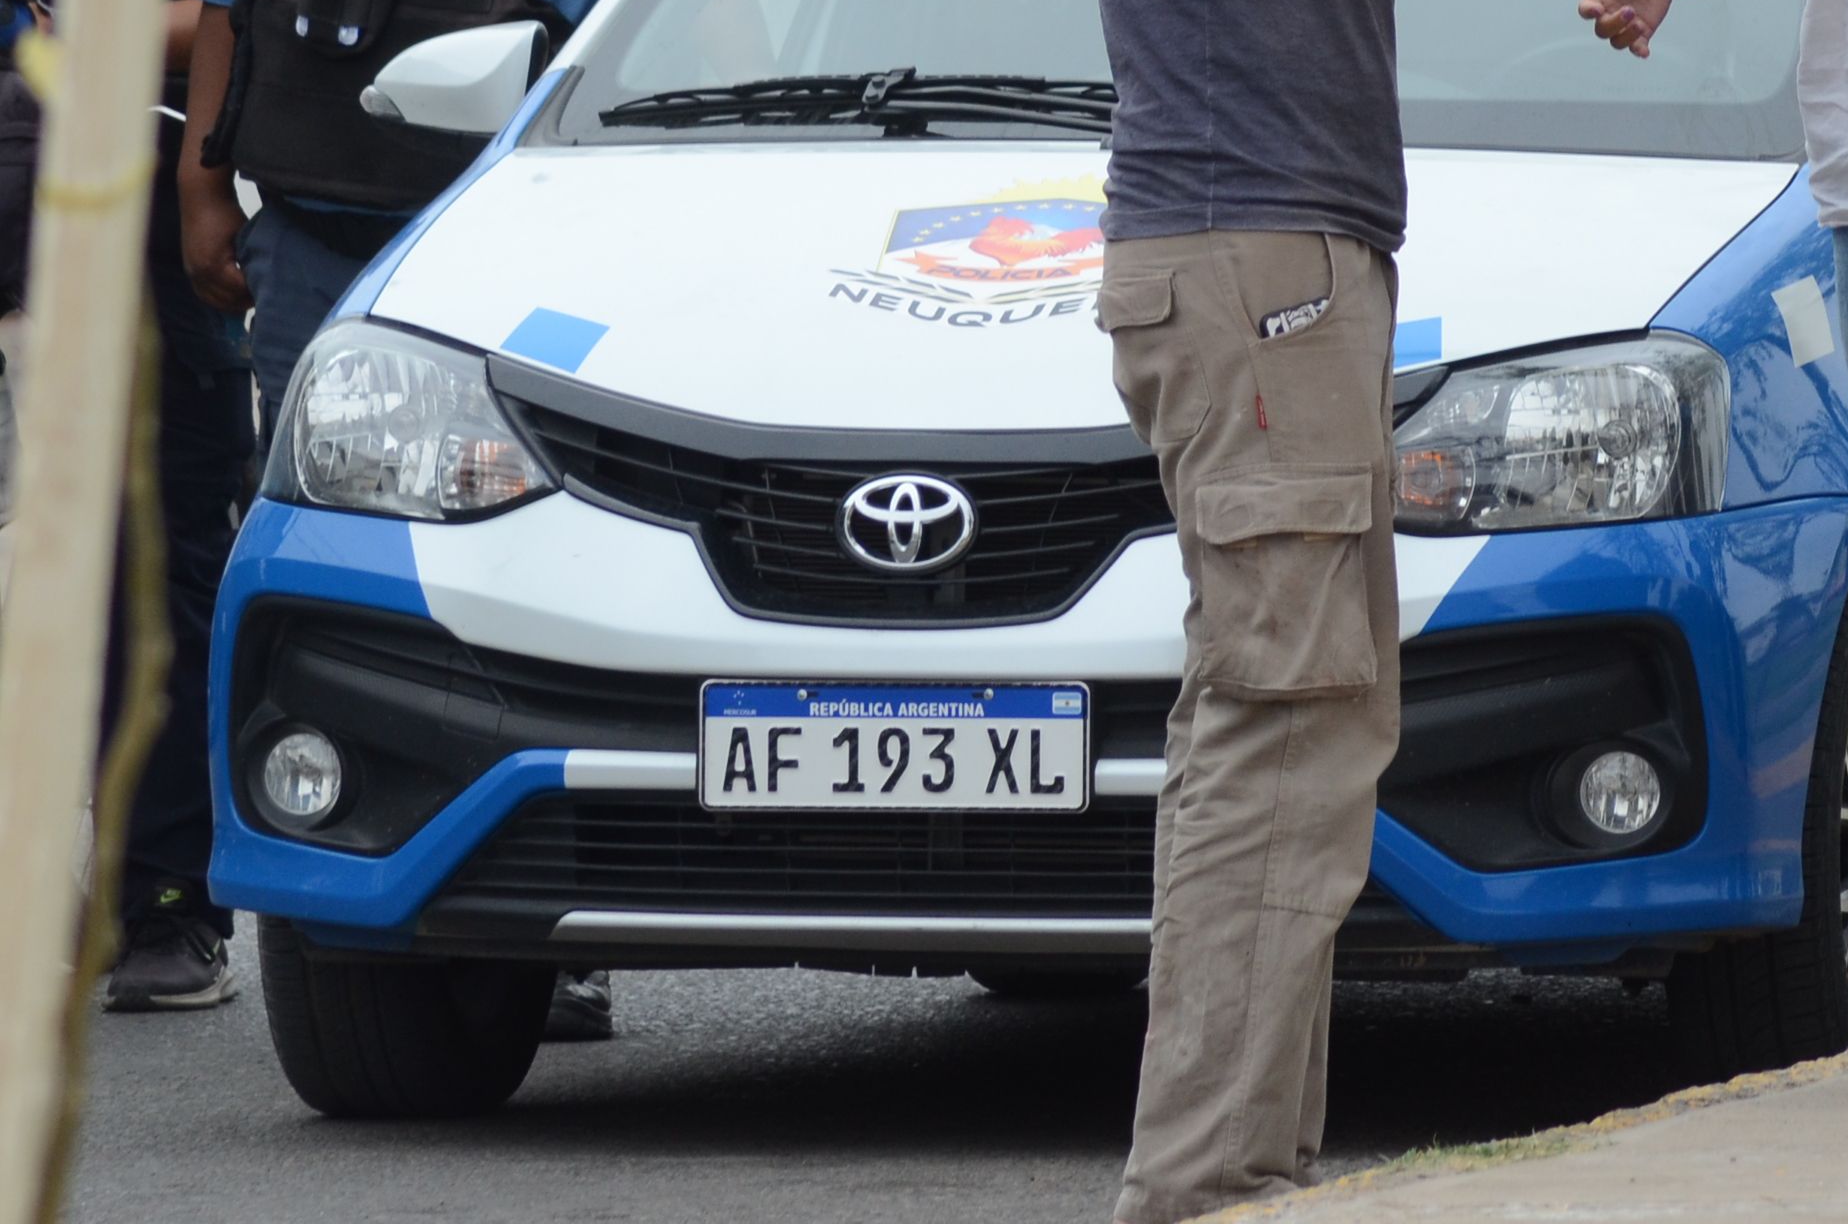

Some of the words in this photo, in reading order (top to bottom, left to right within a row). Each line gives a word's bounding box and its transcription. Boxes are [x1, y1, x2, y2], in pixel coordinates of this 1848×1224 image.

[828, 283, 1098, 328] NEUQUE
[809, 697, 893, 717] REPÚBLICA
[898, 702, 985, 718] ARGENTINA
[723, 727, 802, 793] AF
[832, 727, 955, 793] 193
[986, 728, 1065, 794] XL
